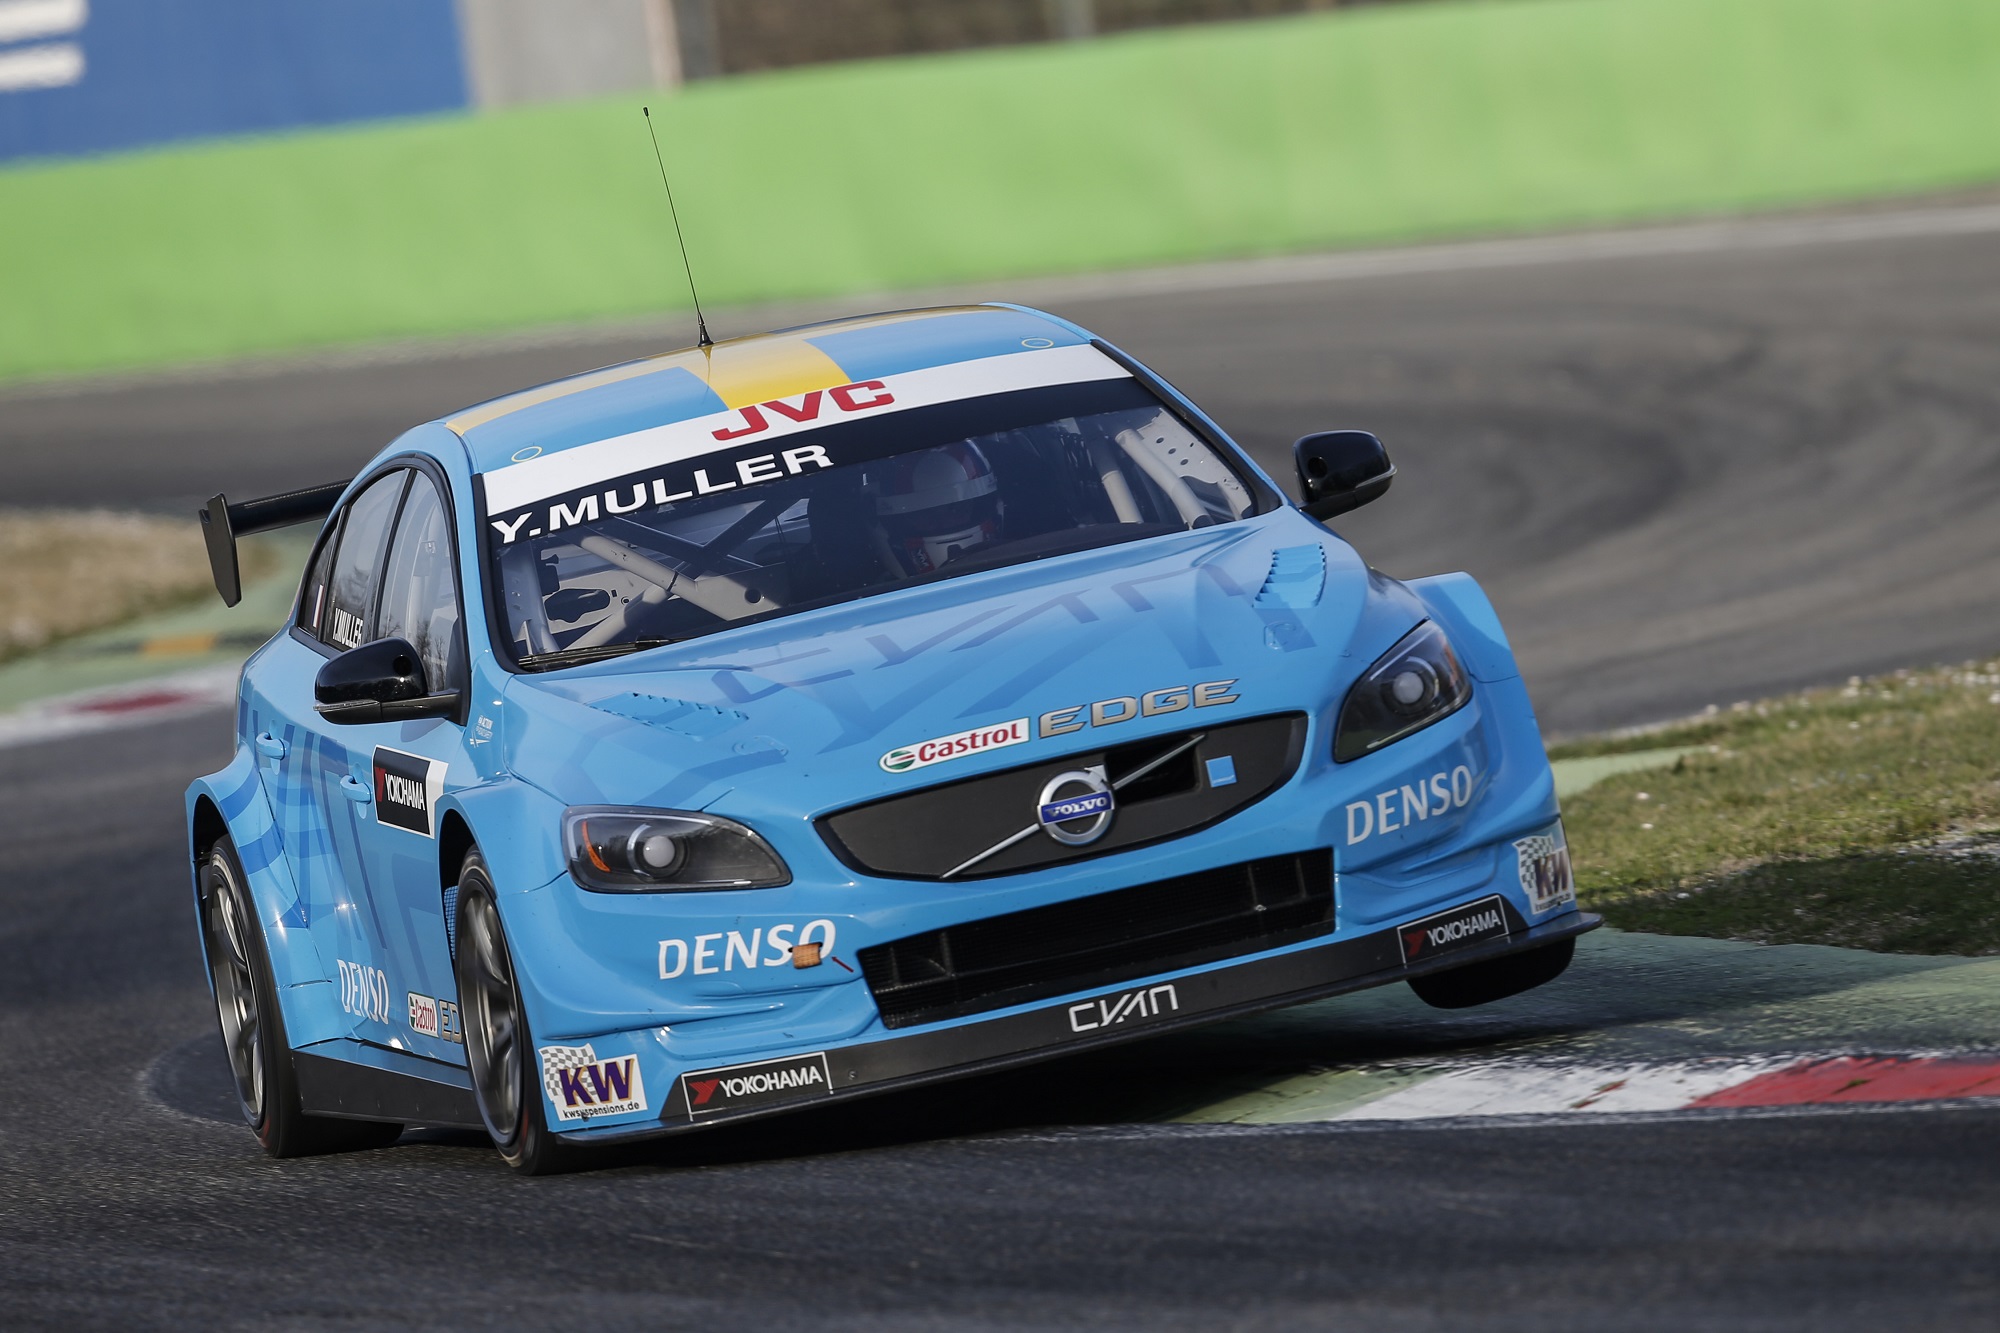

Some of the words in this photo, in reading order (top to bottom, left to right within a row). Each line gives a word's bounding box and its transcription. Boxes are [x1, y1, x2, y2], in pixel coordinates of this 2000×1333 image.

[711, 380, 895, 441] JVC
[491, 444, 834, 544] Y.MULLER
[918, 722, 1022, 762] Castrol
[1038, 678, 1240, 738] EDGE
[384, 773, 426, 811] YOKOHAMA
[1045, 797, 1108, 817] VOLVO
[1345, 765, 1472, 846] DENSO
[658, 919, 836, 980] DENSO
[1427, 909, 1501, 946] YOKOHAMA
[337, 959, 389, 1025] DENSO
[1068, 984, 1179, 1032] CYAN
[415, 999, 436, 1032] Castrol
[438, 998, 462, 1044] ED
[559, 1058, 635, 1109] KW
[719, 1065, 823, 1098] YOKOHAMA
